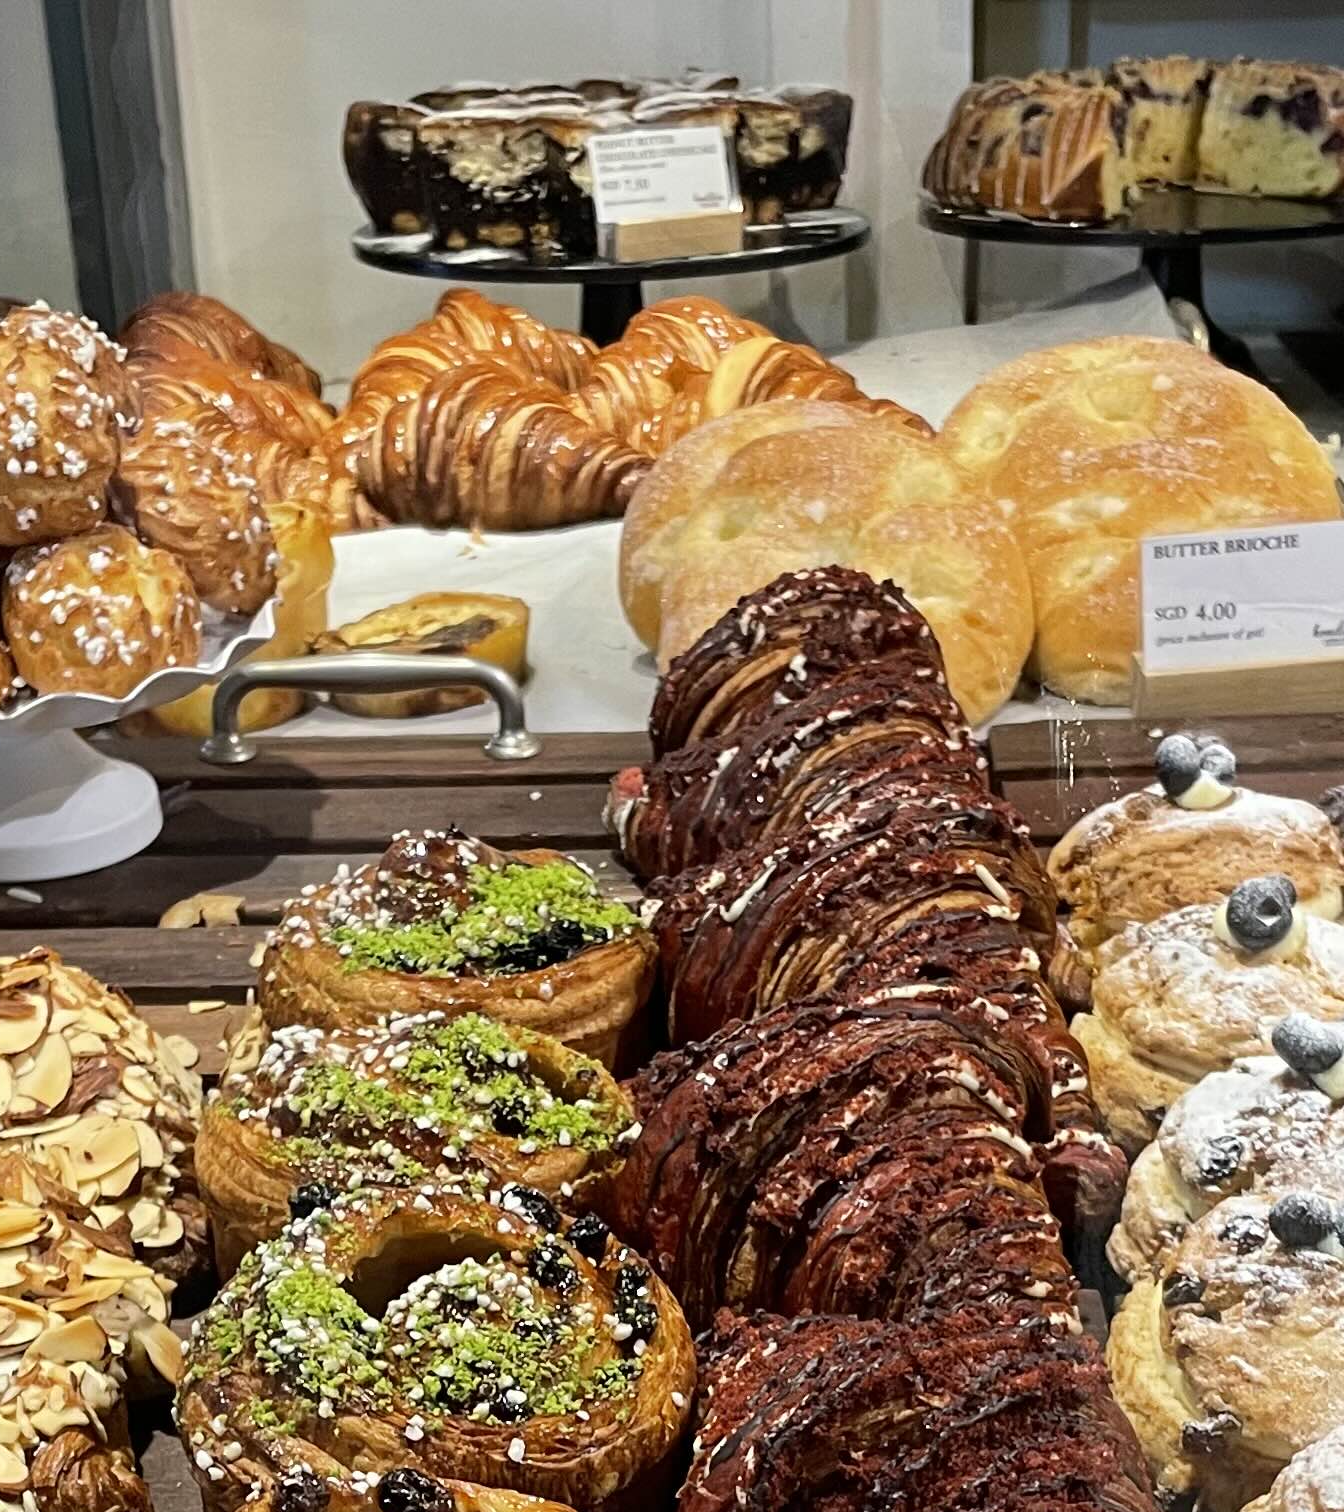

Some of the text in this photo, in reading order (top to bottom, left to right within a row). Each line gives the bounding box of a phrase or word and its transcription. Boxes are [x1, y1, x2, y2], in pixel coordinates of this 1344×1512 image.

[1153, 533, 1300, 560] BUTTER BRIOCHE
[1153, 601, 1237, 621] SGD 4.00
